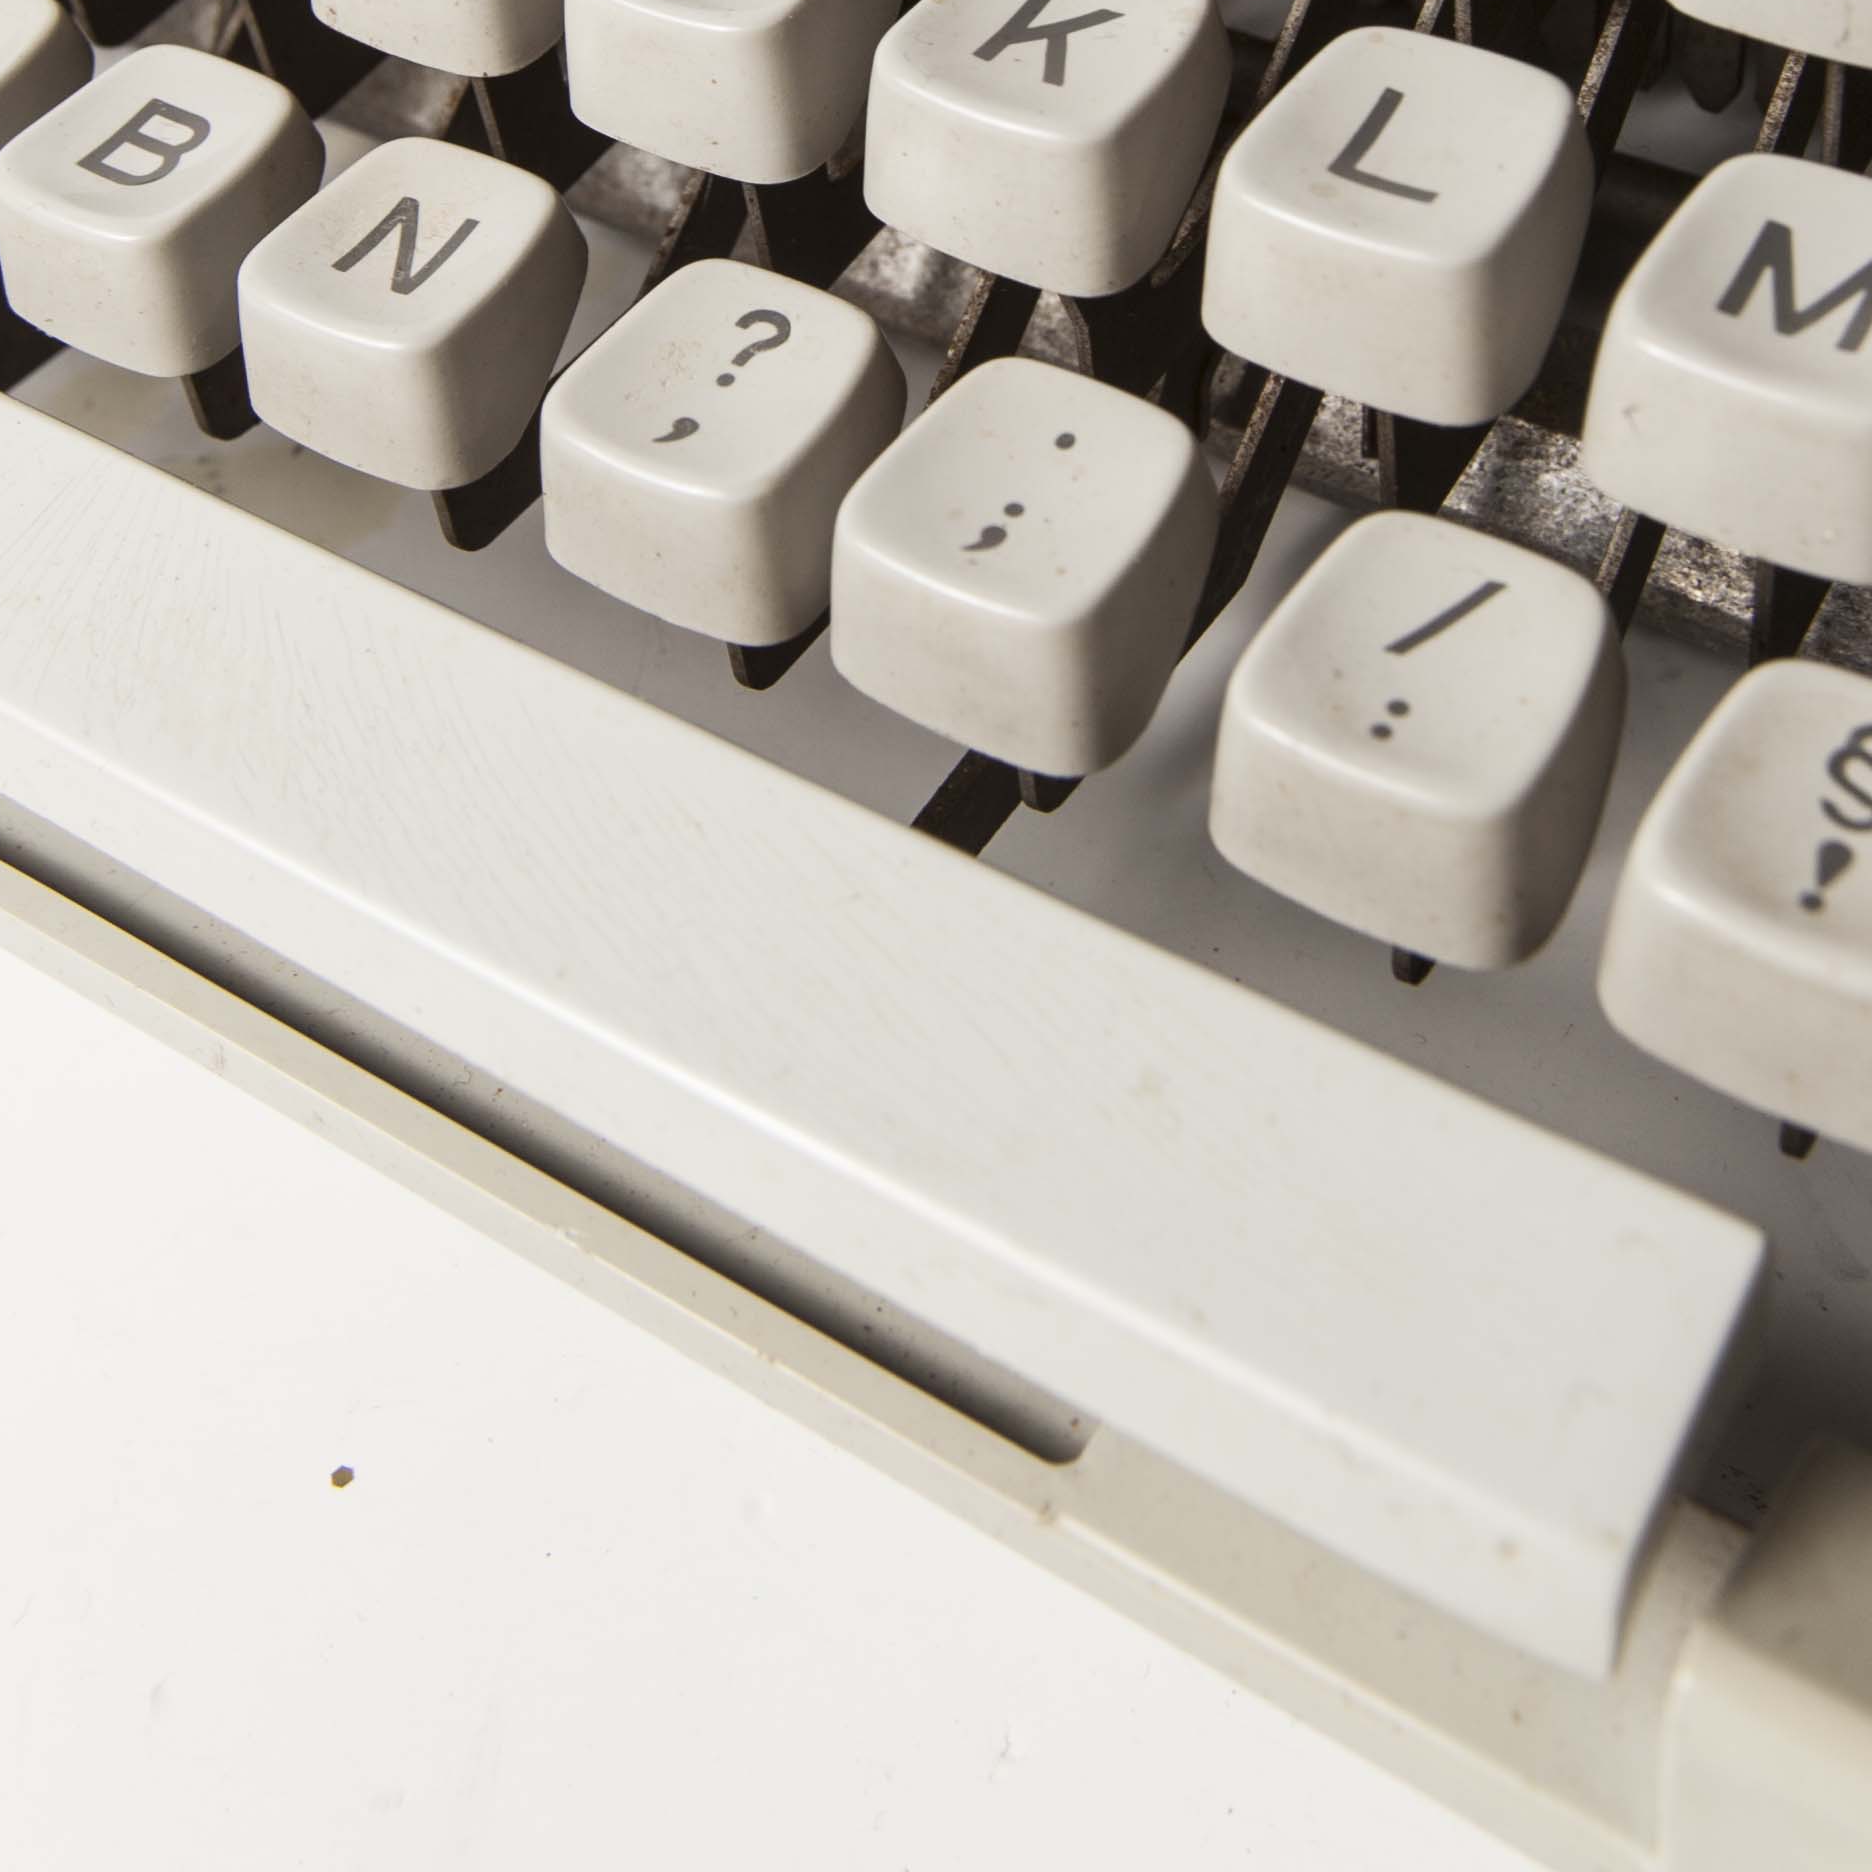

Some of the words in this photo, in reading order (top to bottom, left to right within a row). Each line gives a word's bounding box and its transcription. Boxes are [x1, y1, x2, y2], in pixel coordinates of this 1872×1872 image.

[77, 97, 212, 186] B
[1328, 88, 1437, 202] L
[331, 196, 481, 296] N
[716, 309, 791, 387] ?
[1799, 840, 1854, 912] !
